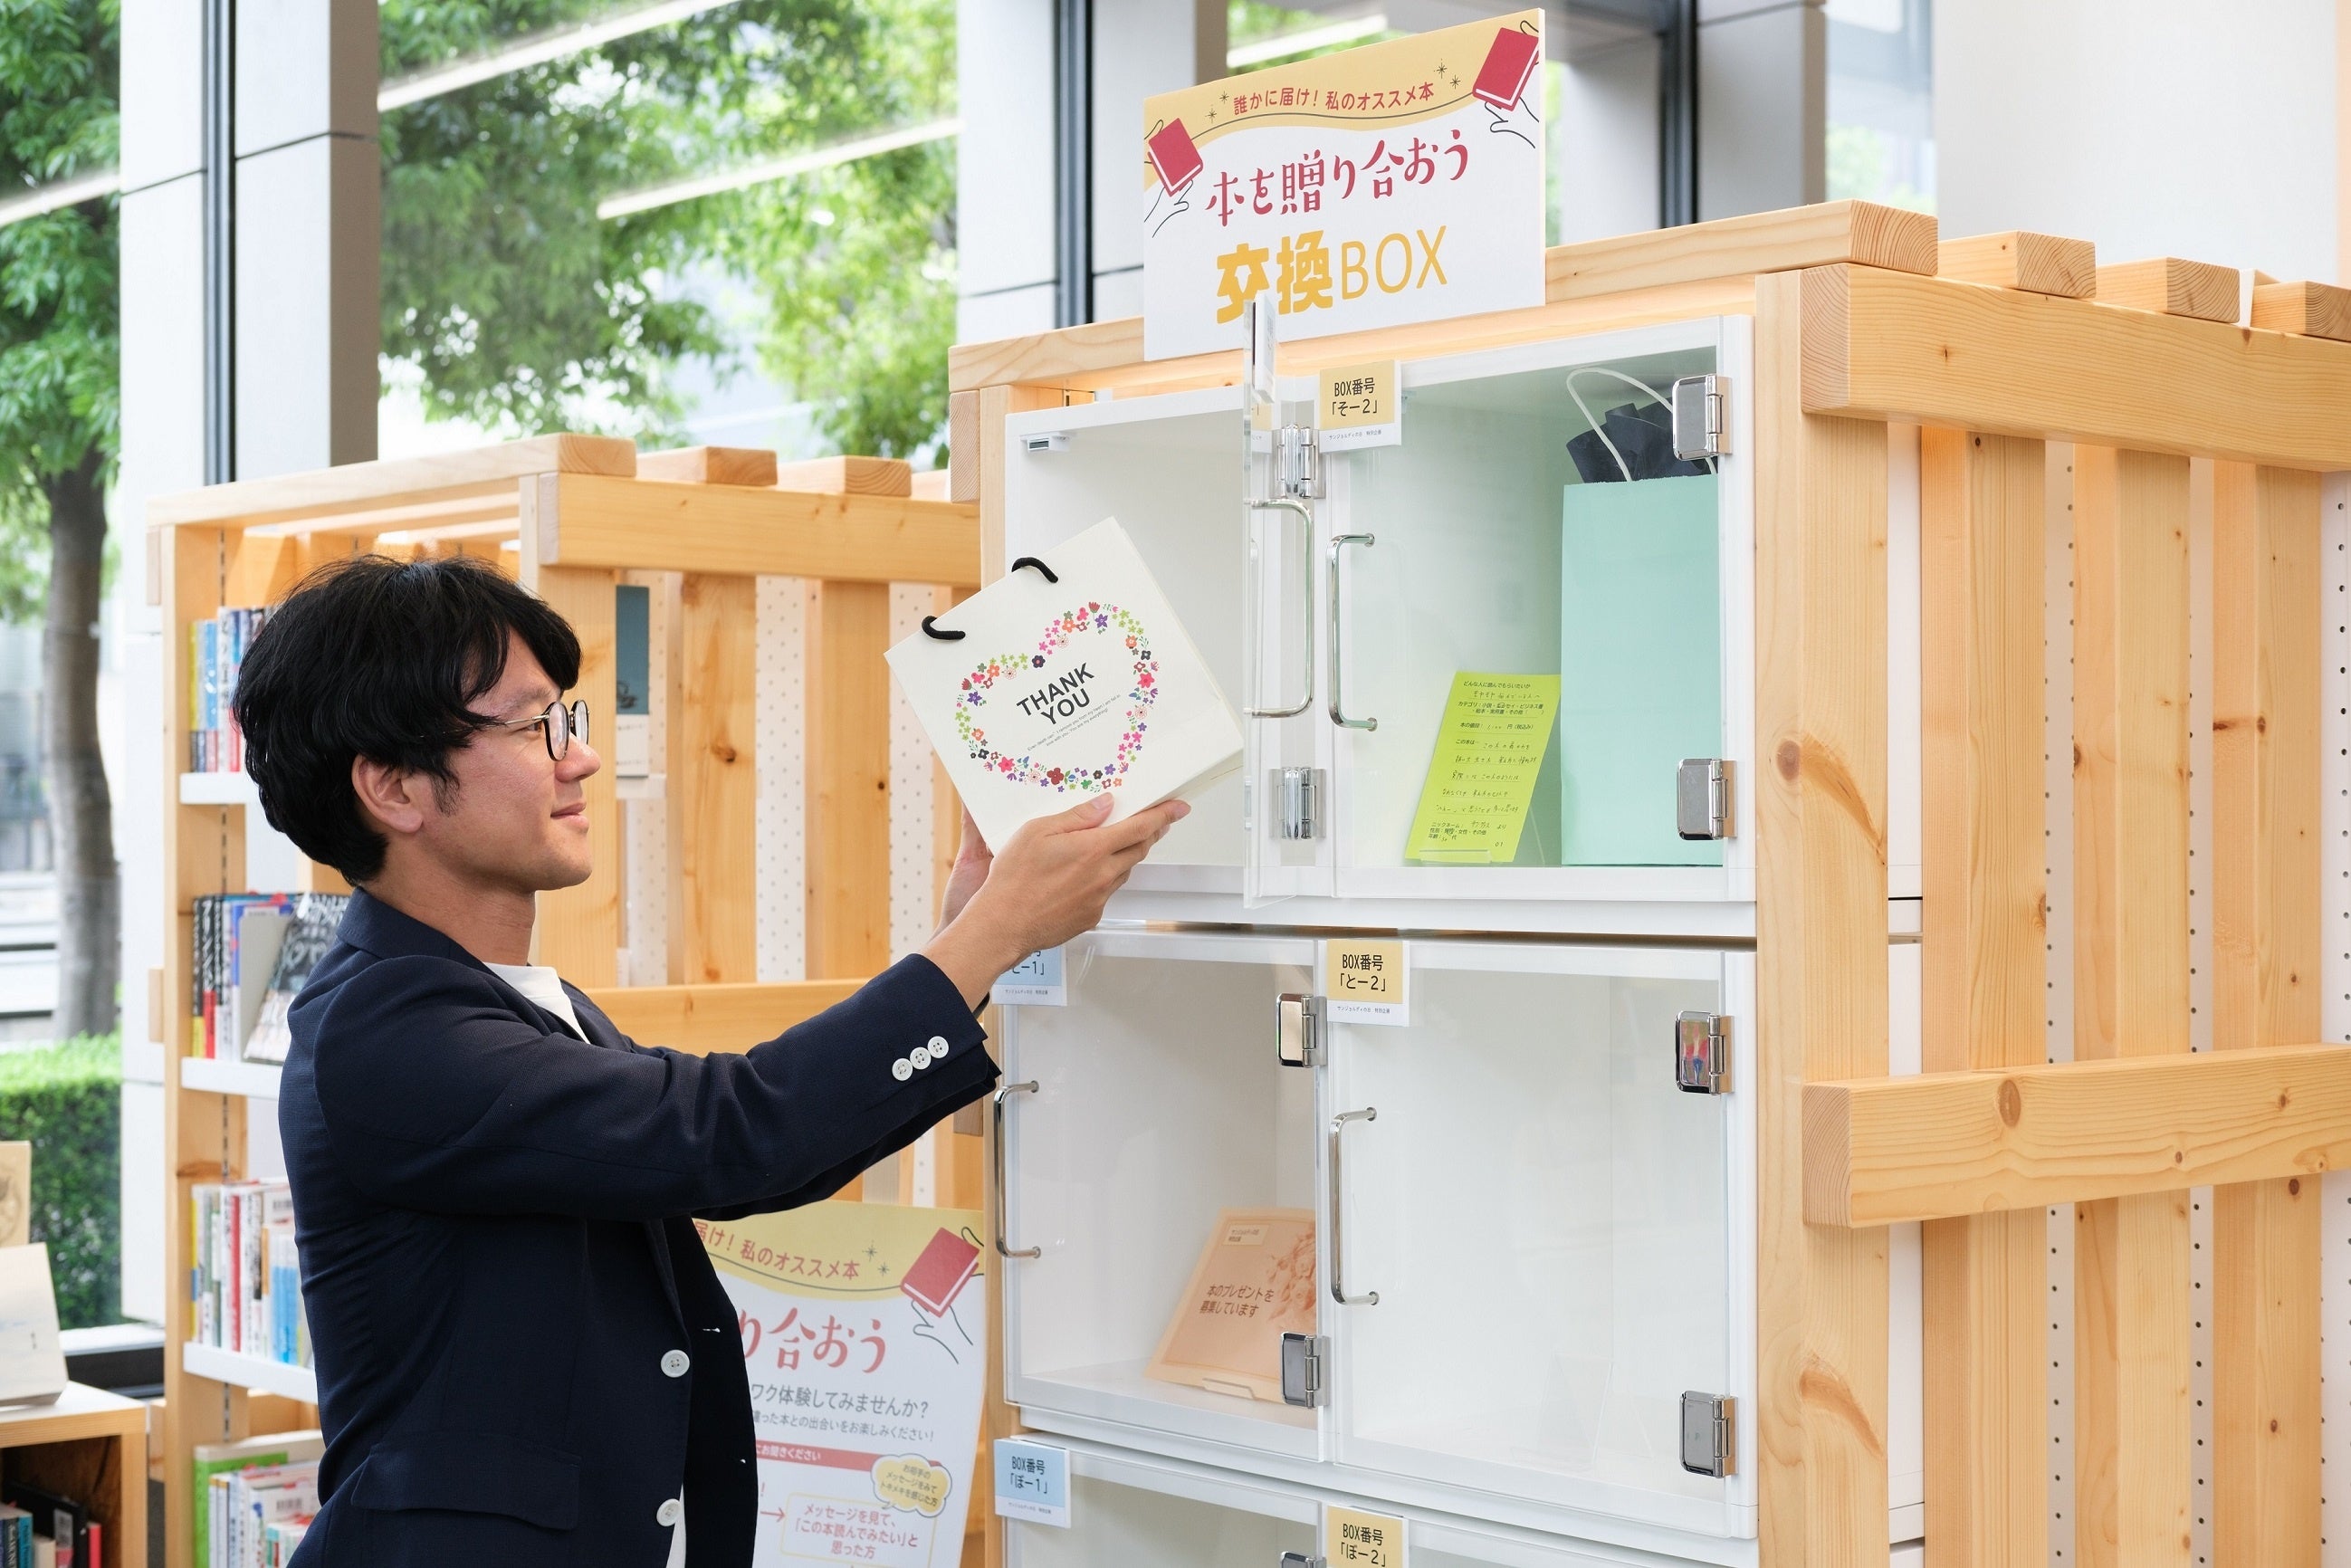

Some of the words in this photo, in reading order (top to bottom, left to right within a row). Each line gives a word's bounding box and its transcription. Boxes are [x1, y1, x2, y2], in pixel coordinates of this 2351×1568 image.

[1204, 129, 1469, 227] 本を贈り合おう
[1216, 225, 1448, 324] 交換BOX
[1333, 377, 1375, 397] BOX番号
[1016, 662, 1094, 716] THANK
[1040, 688, 1090, 725] YOU
[1342, 953, 1384, 971] BOX番号
[1207, 1283, 1274, 1303] 本のプレゼントを
[739, 1306, 886, 1374] り合おう
[751, 1383, 930, 1420] ワク体験してみませんか？
[1011, 1455, 1046, 1476] BOX番号
[1343, 1523, 1384, 1546] BOX番号
[830, 1540, 876, 1560] 思った方
